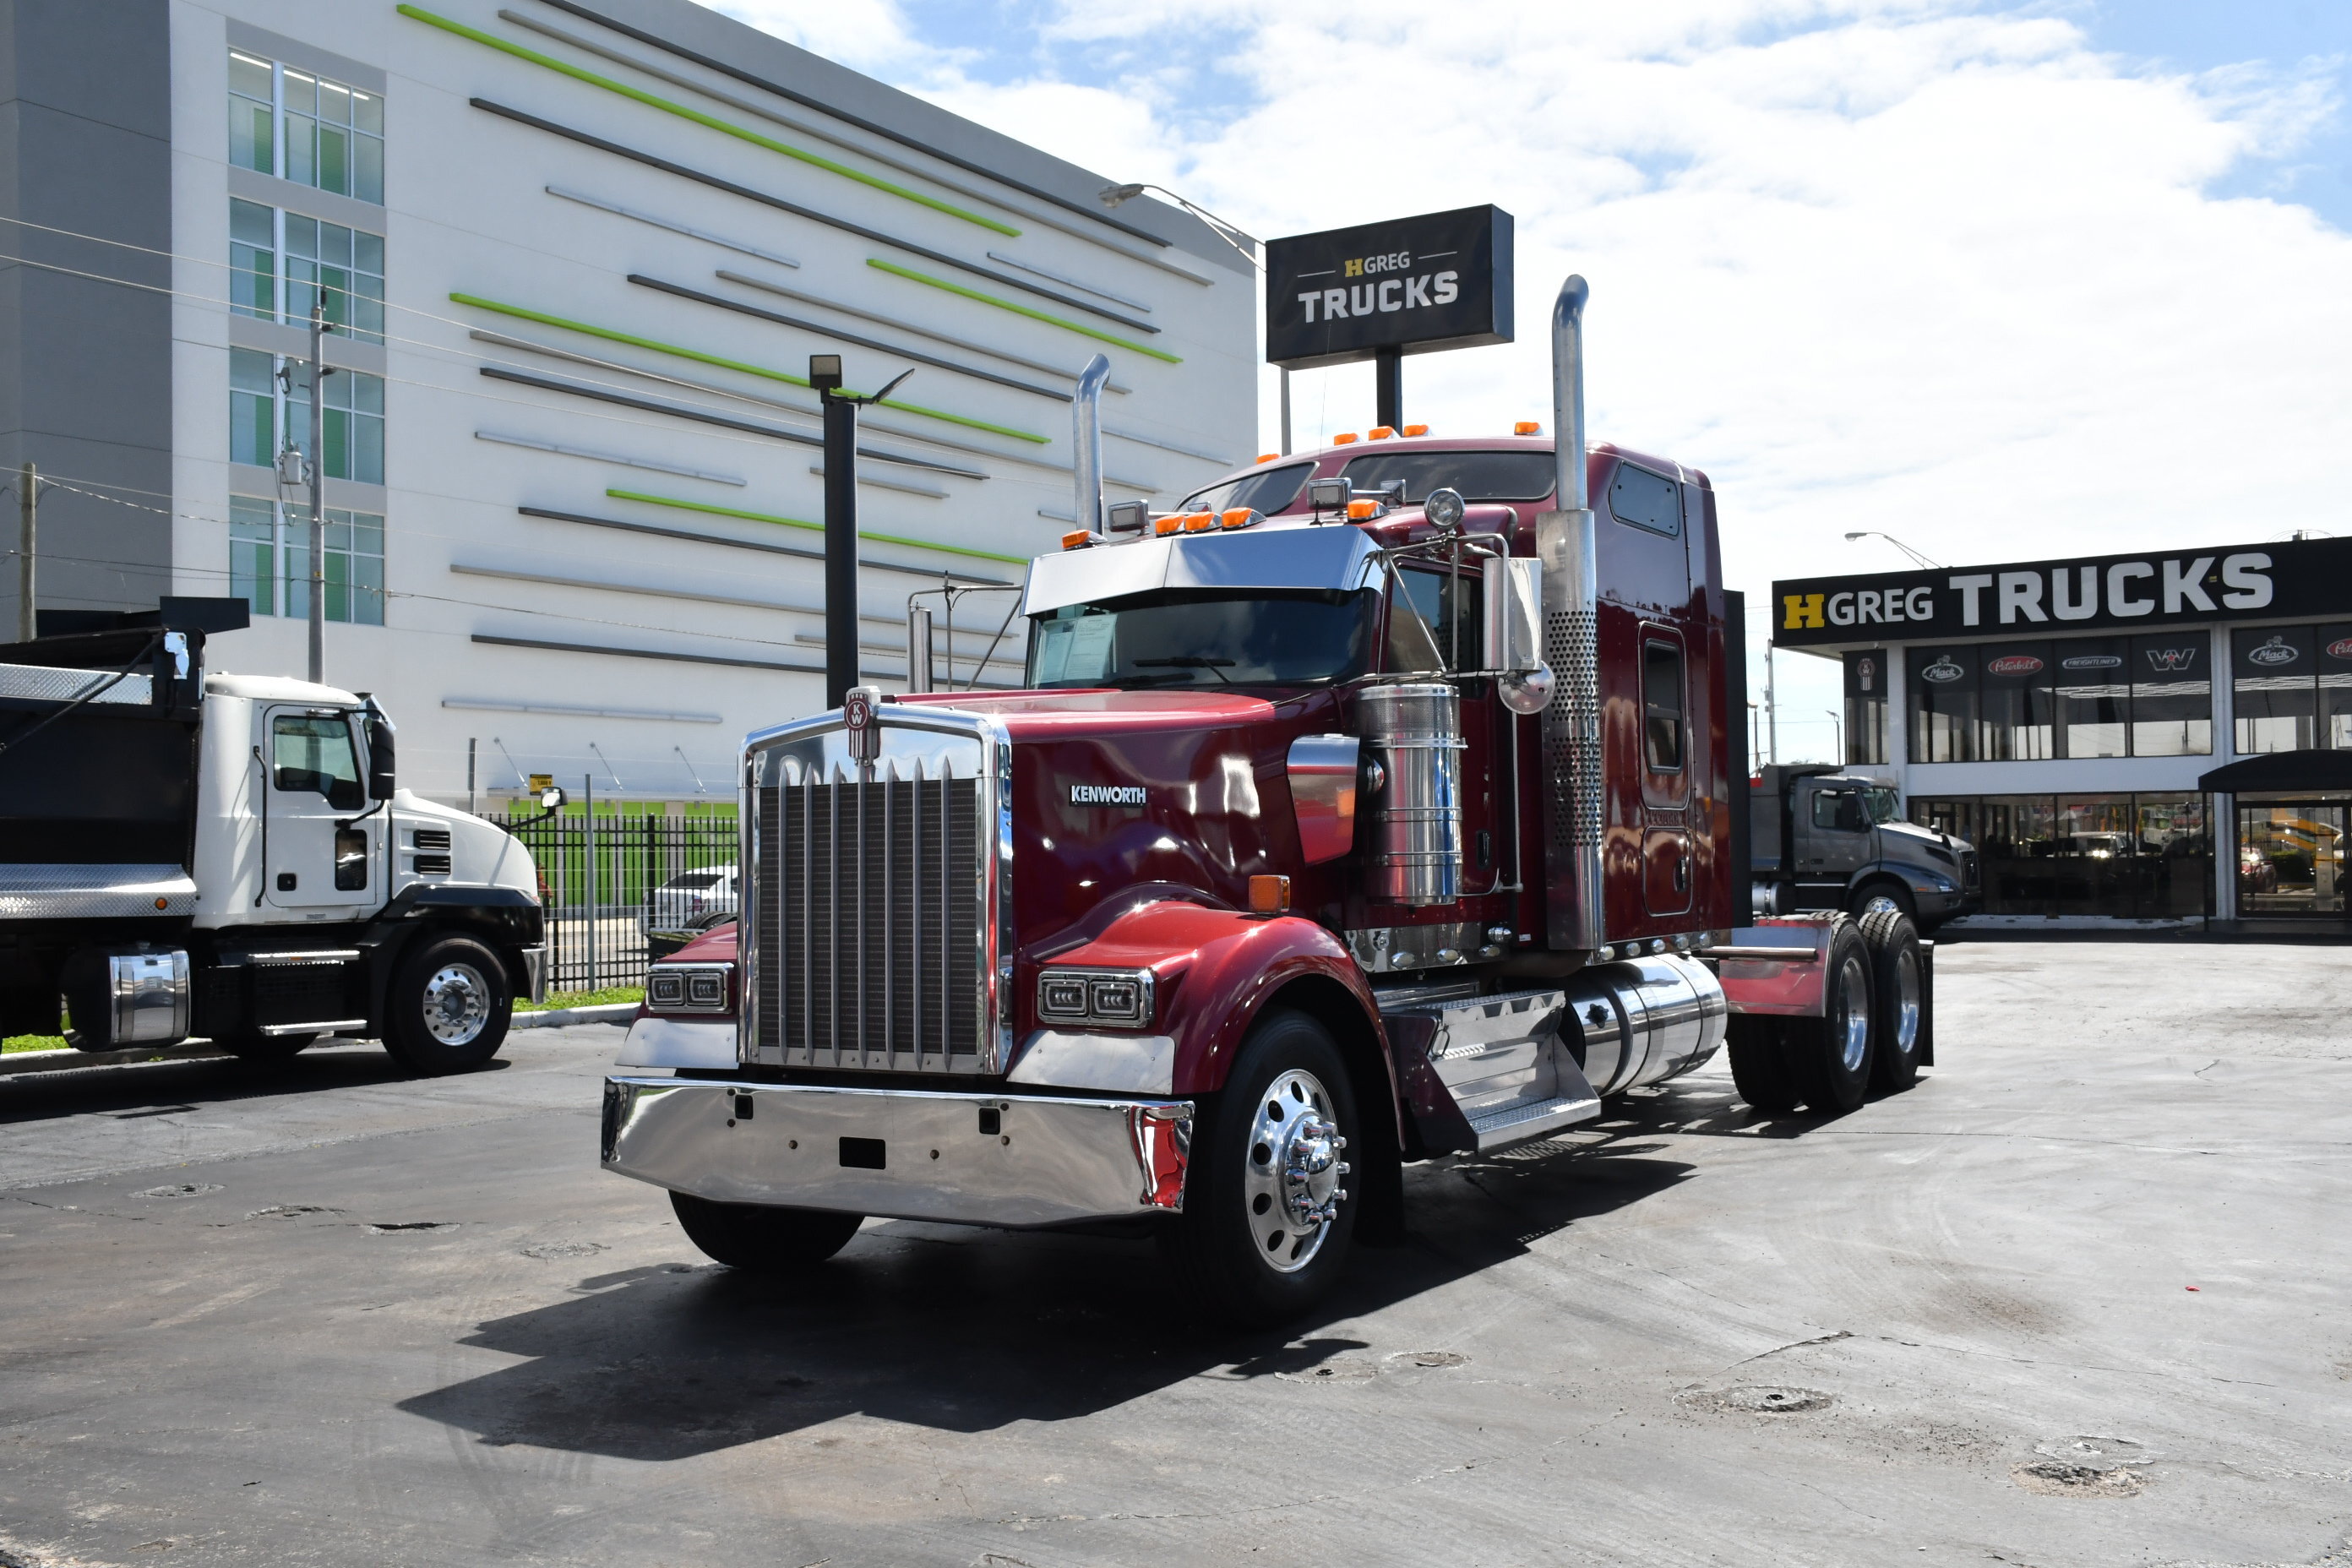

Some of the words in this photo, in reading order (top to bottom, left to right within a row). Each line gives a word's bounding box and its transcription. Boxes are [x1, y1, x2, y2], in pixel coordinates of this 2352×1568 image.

[1298, 270, 1458, 323] TRUCKS
[1949, 553, 2273, 627] TRUCKS
[2257, 649, 2290, 662] Mack
[1930, 666, 1956, 678] Mack
[1995, 657, 2039, 672] Peterbilt
[1071, 785, 1146, 803] KENWORTH
